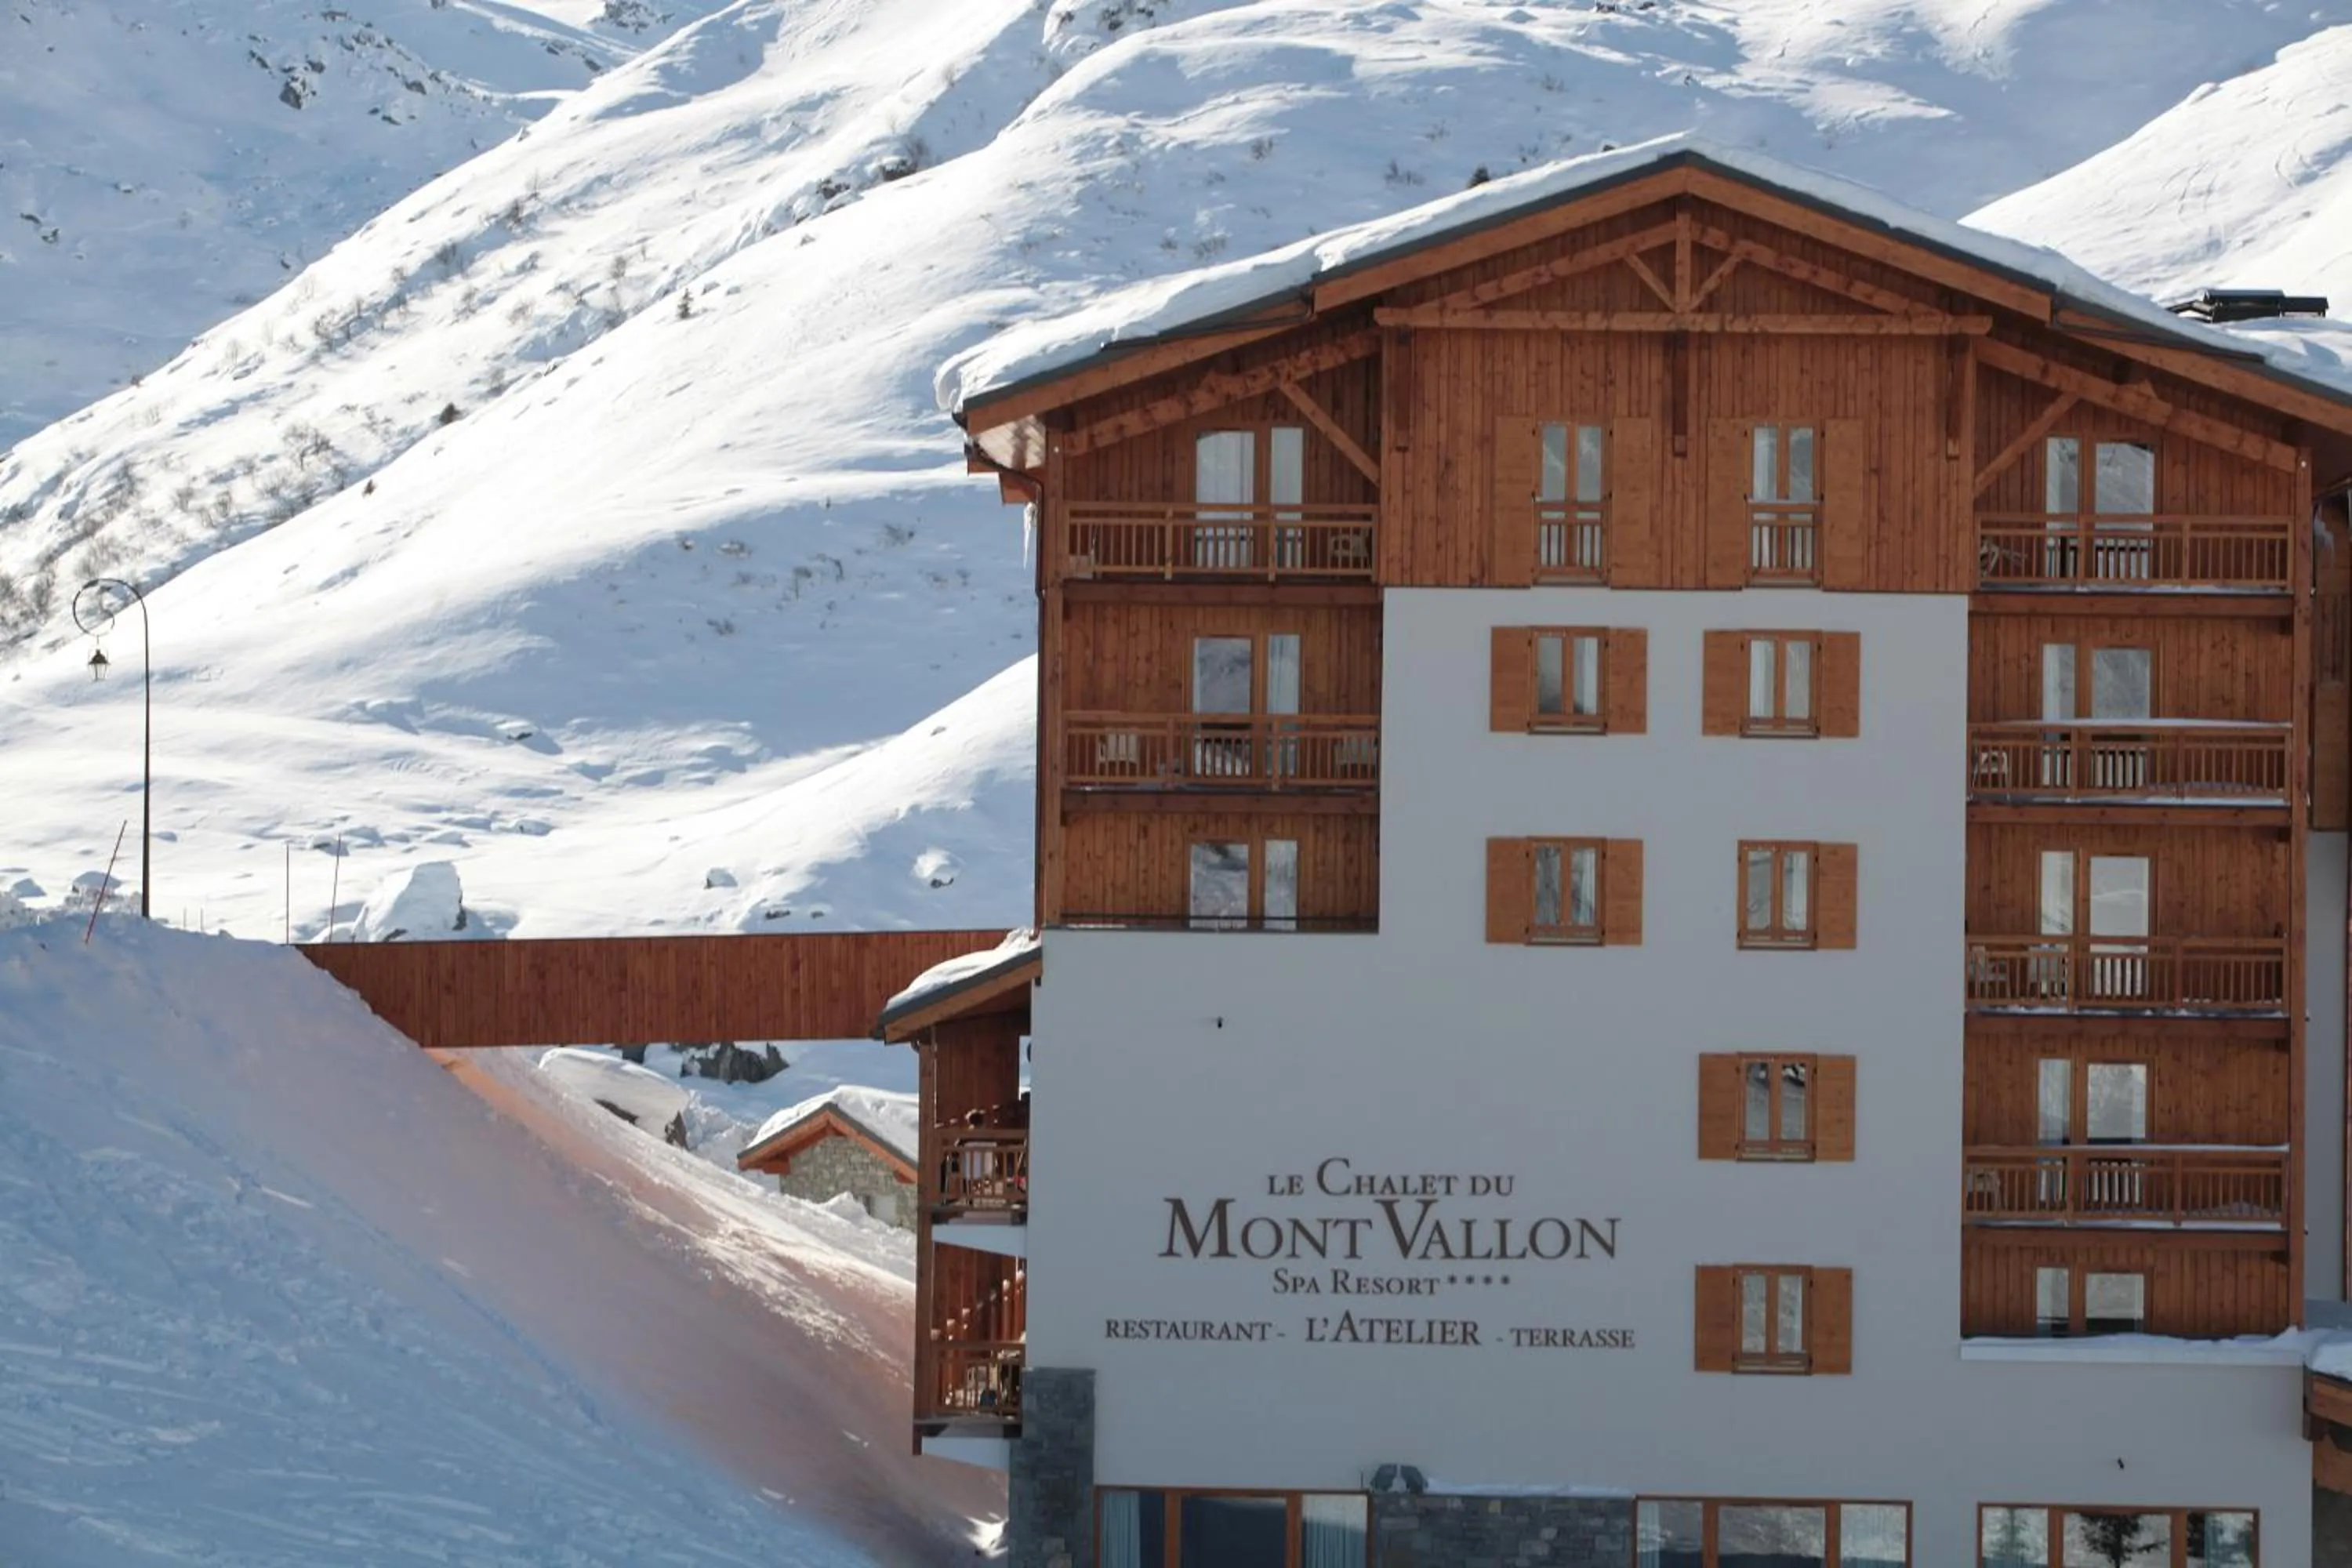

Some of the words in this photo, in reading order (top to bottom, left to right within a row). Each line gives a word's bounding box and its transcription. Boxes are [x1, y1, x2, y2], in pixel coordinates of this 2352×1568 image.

[1268, 1174, 1305, 1196] LE
[1469, 1174, 1514, 1197] DU
[1157, 1197, 1373, 1260] MONT
[1373, 1198, 1621, 1261] VALLON
[1509, 1328, 1635, 1349] TERRASSE
